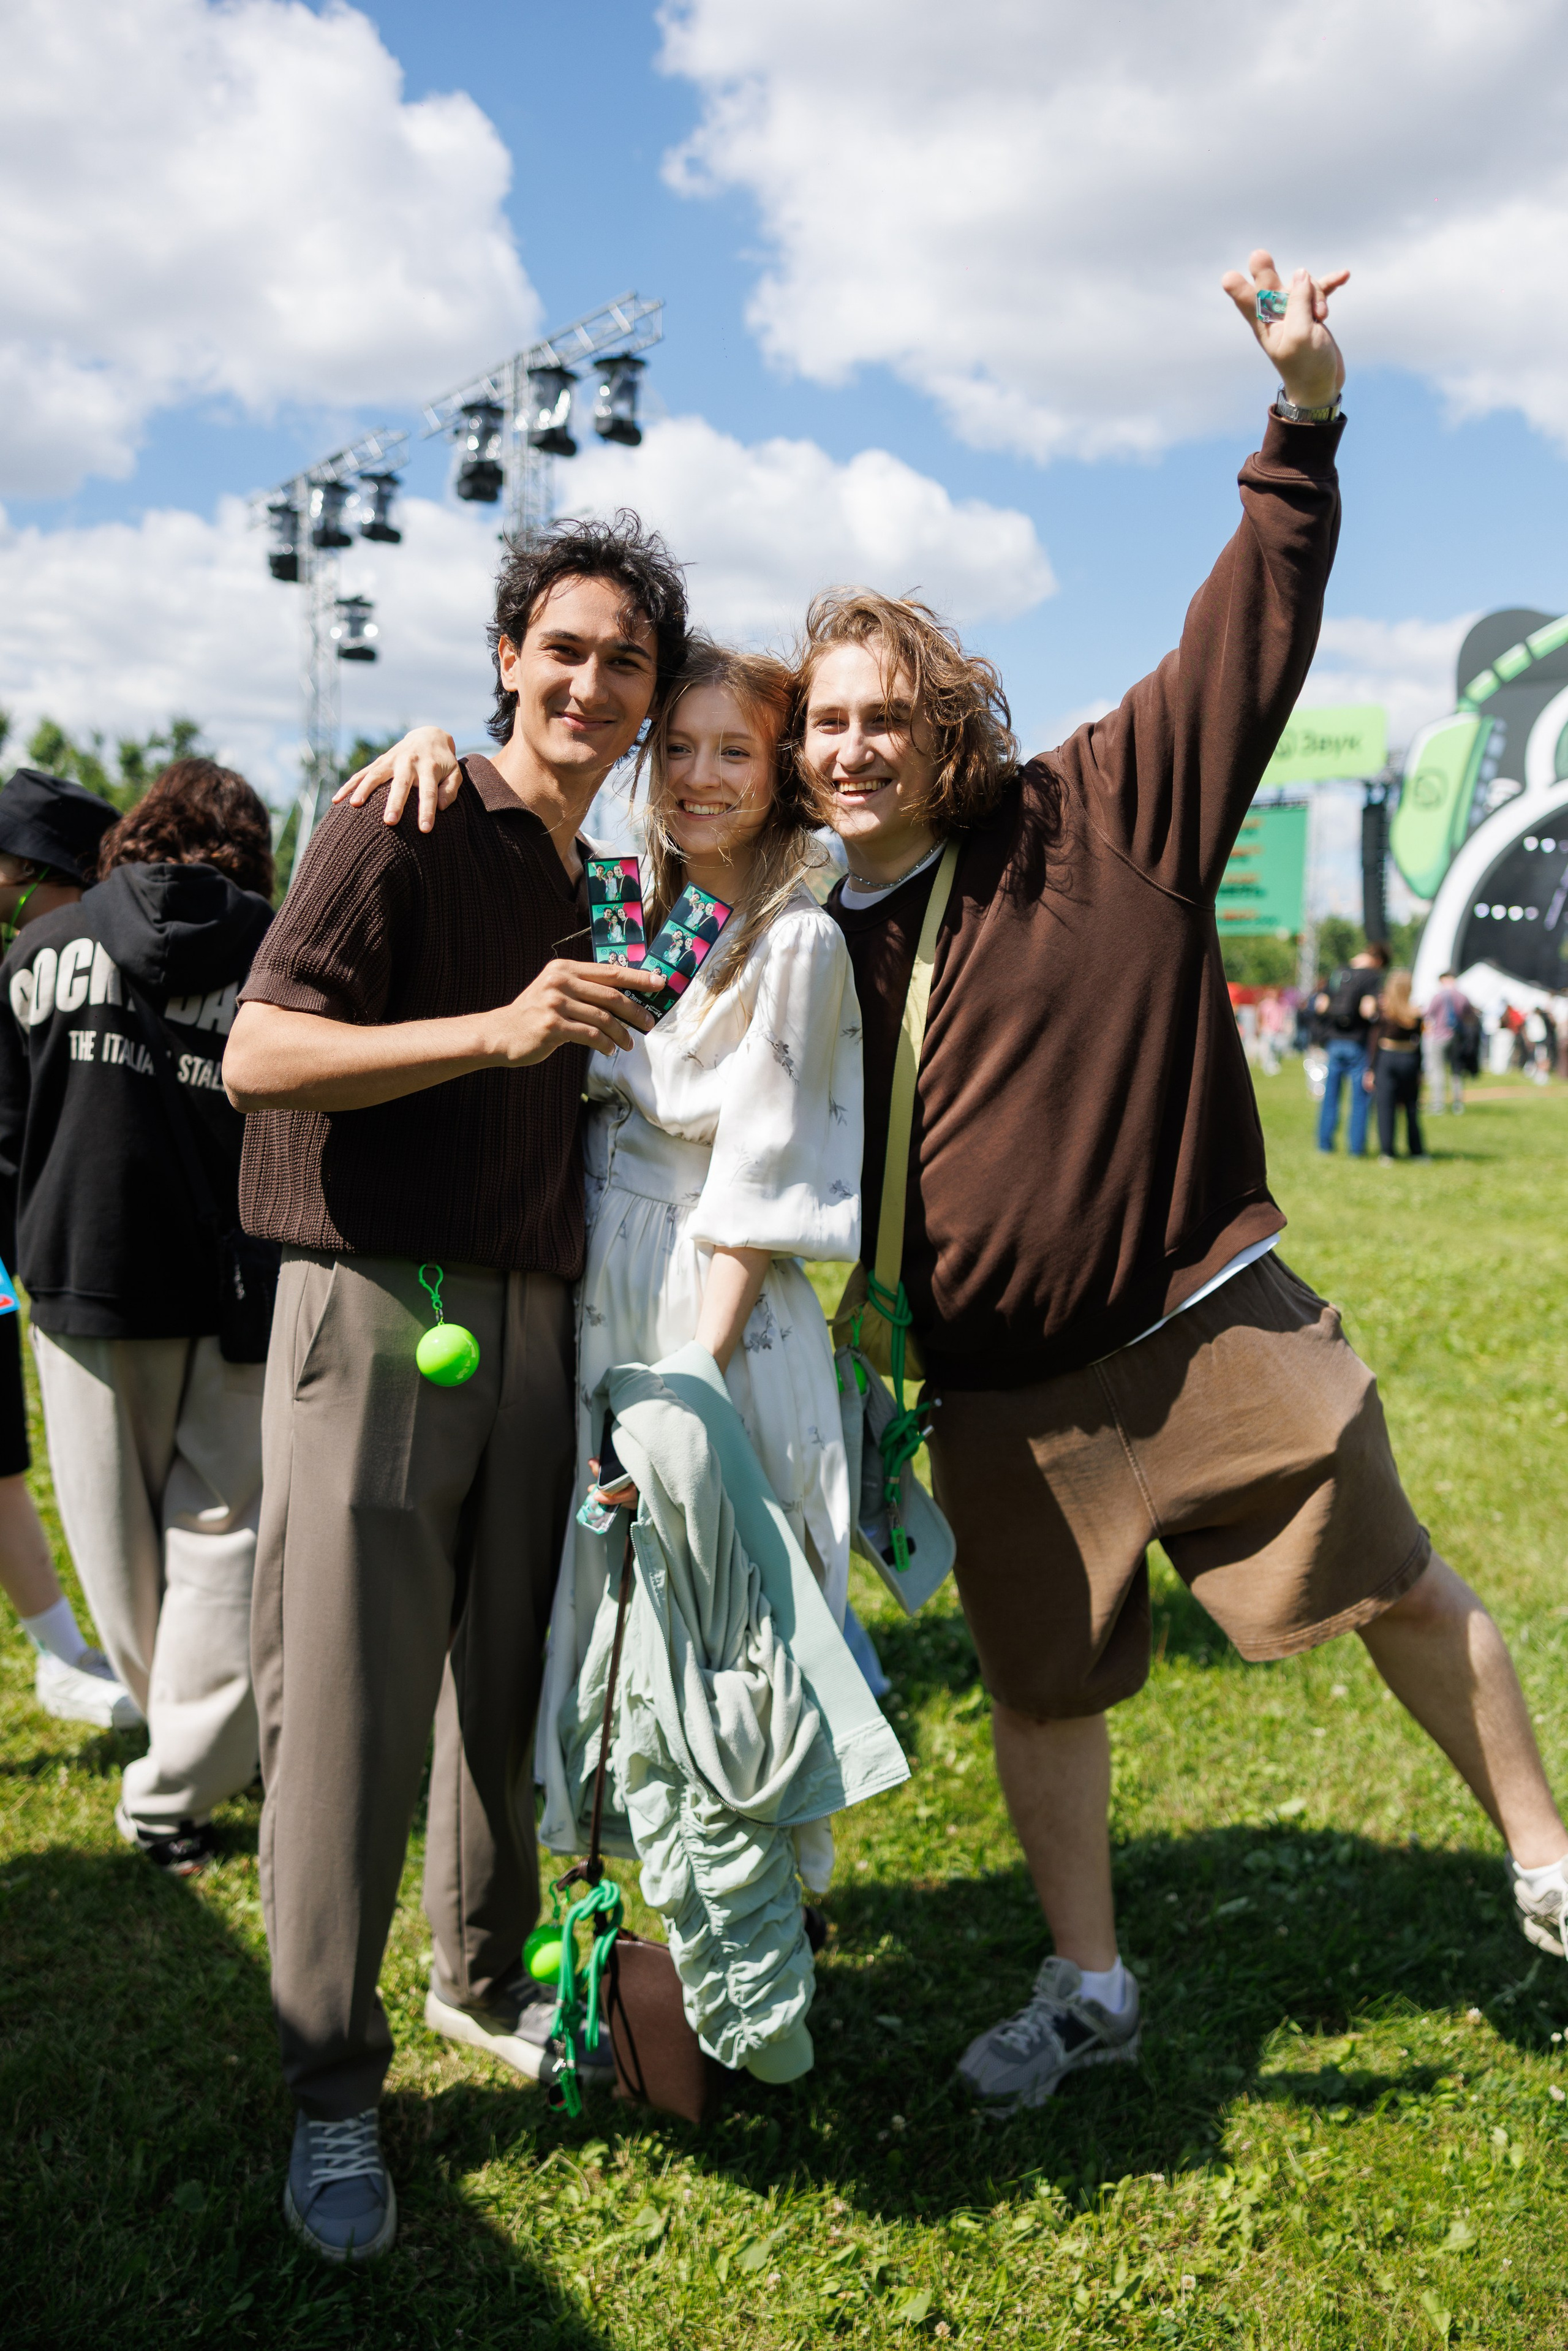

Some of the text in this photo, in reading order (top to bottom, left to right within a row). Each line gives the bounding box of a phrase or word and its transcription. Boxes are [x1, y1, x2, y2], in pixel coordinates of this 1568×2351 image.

[10, 938, 136, 1034] OCK
[630, 994, 643, 1005] Звук
[69, 1030, 225, 1093] THE ITALIA STAL
